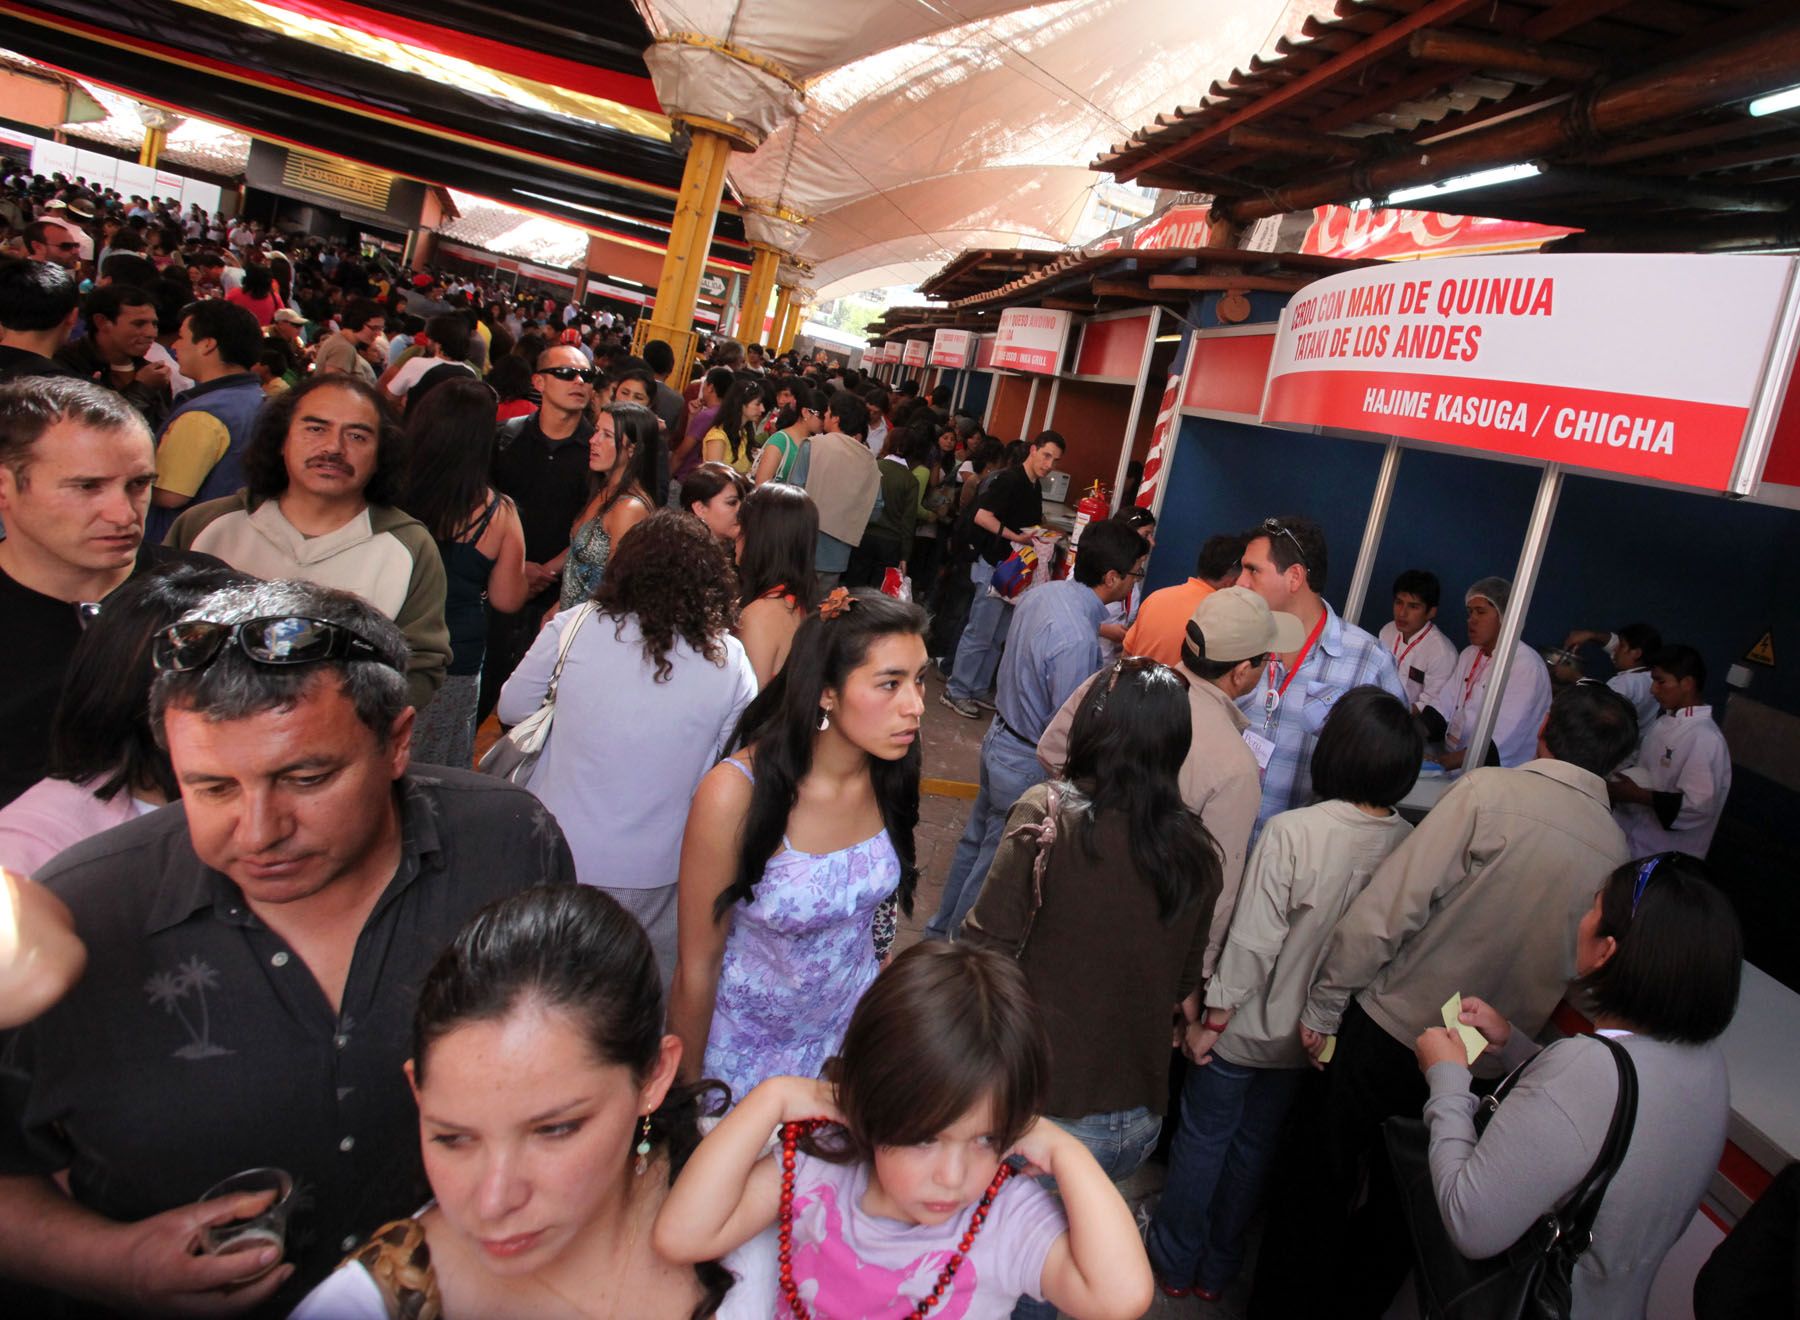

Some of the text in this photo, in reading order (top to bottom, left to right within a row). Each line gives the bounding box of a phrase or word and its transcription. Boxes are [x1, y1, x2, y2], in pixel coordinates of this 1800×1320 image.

[1291, 278, 1554, 331] CERDO CON MAKI DE QUINUA
[1295, 325, 1482, 362] TATAKI DE LOS ANDES
[1362, 387, 1675, 455] HAJIME KASUGA / CHICHA
